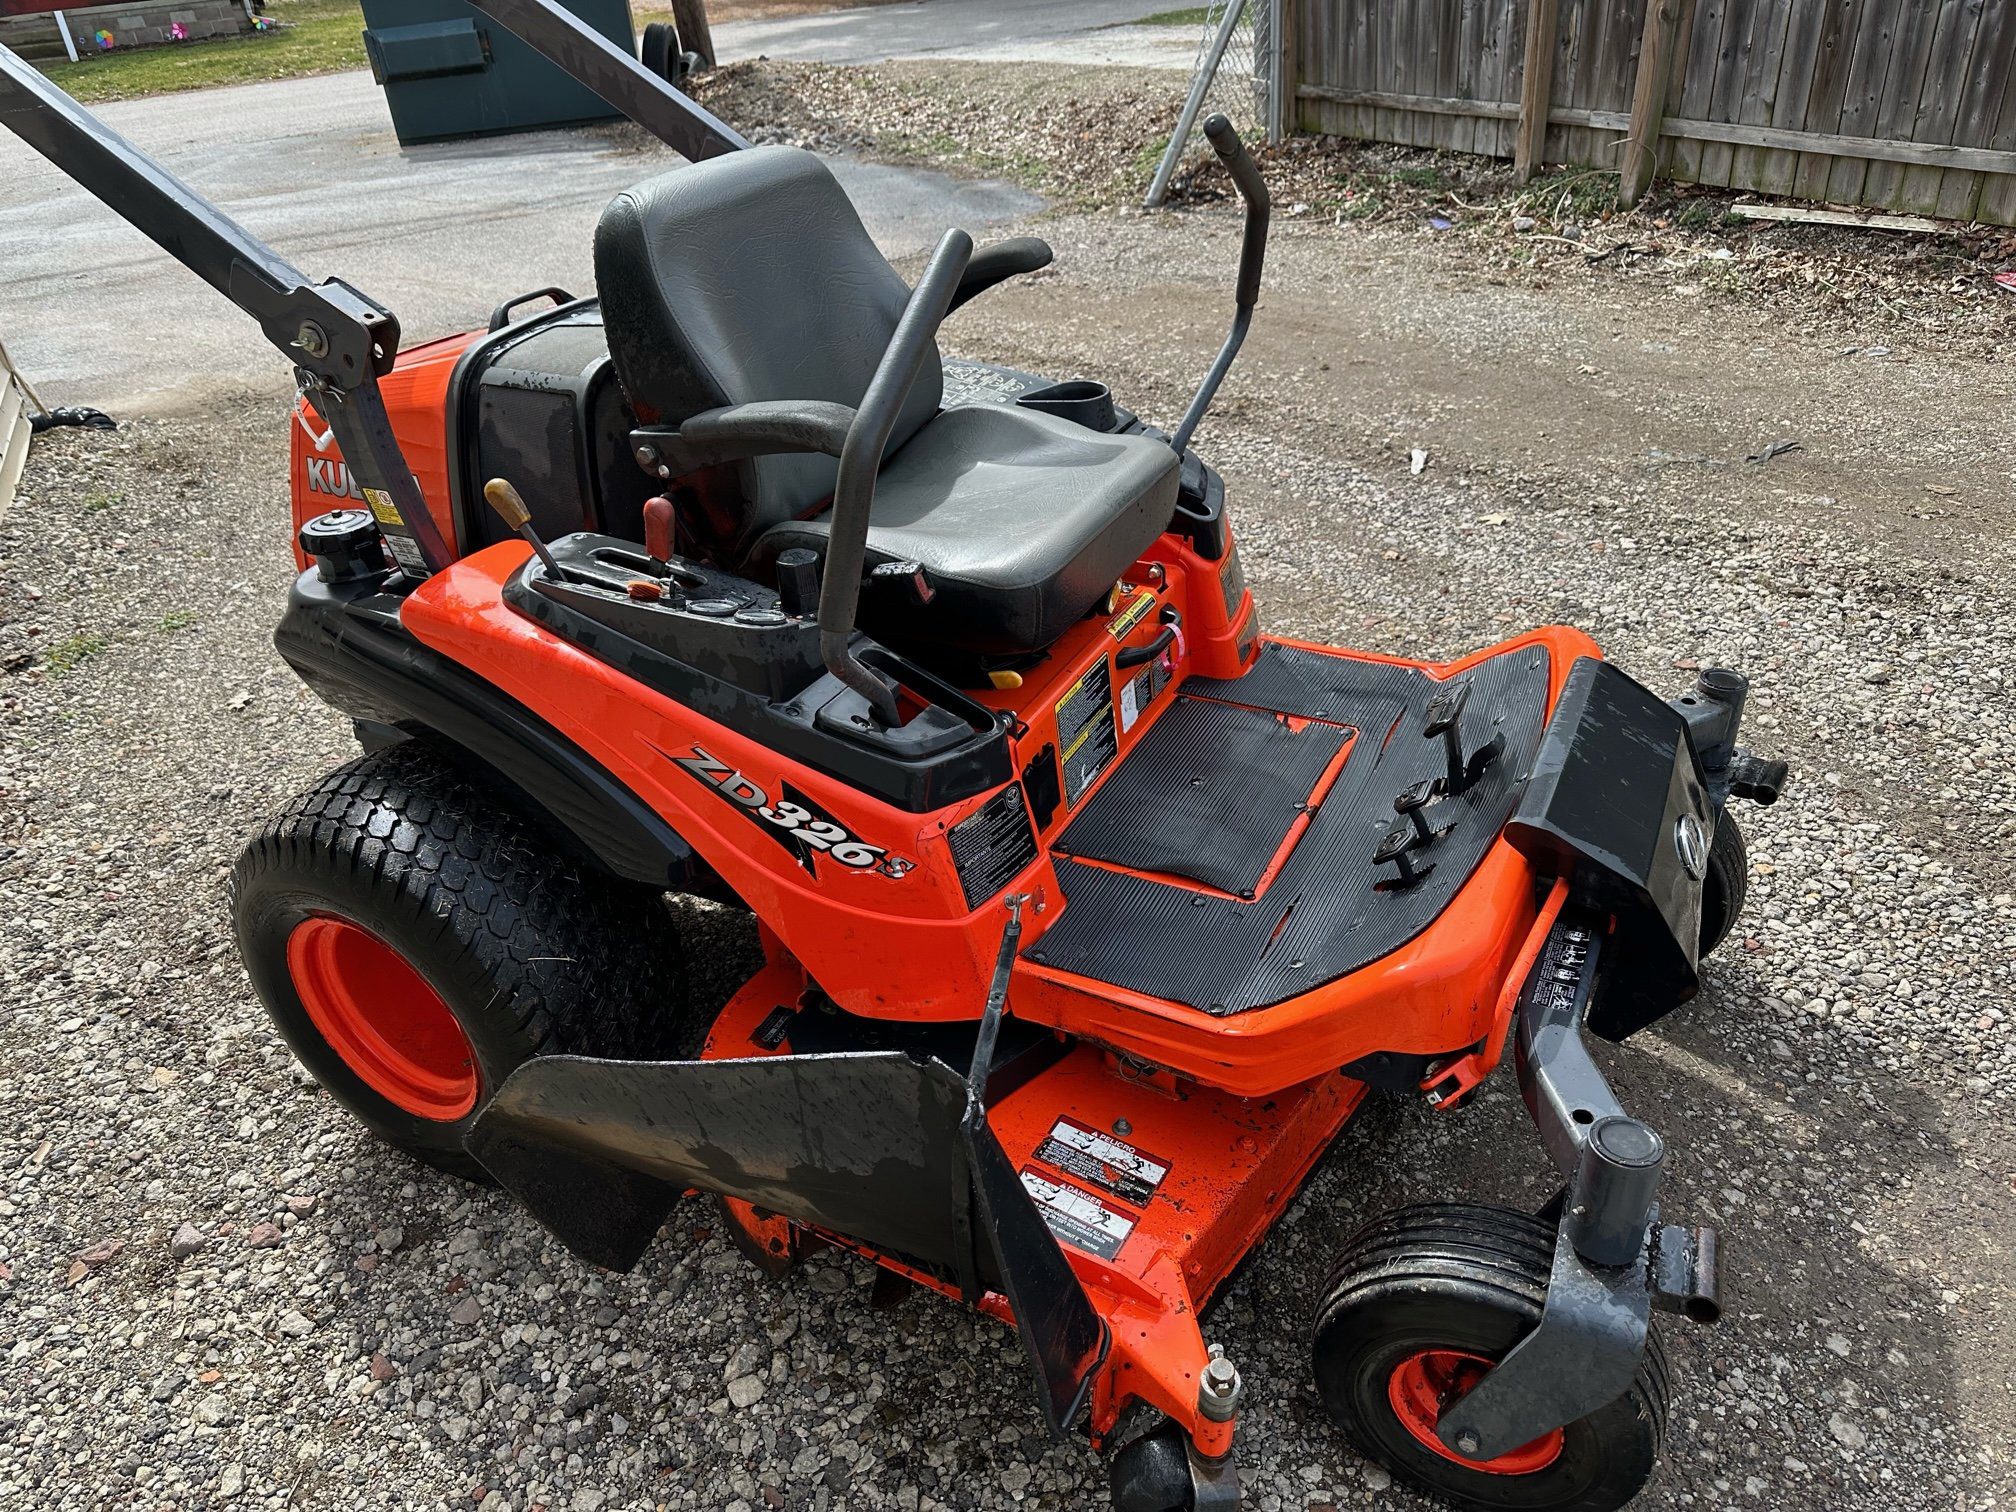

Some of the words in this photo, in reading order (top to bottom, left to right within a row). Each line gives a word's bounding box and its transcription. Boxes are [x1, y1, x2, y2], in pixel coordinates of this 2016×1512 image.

[964, 847, 992, 868] IMPORTANTE
[1098, 1134, 1136, 1153] PELIGRO
[1065, 1185, 1103, 1206] DANGER
